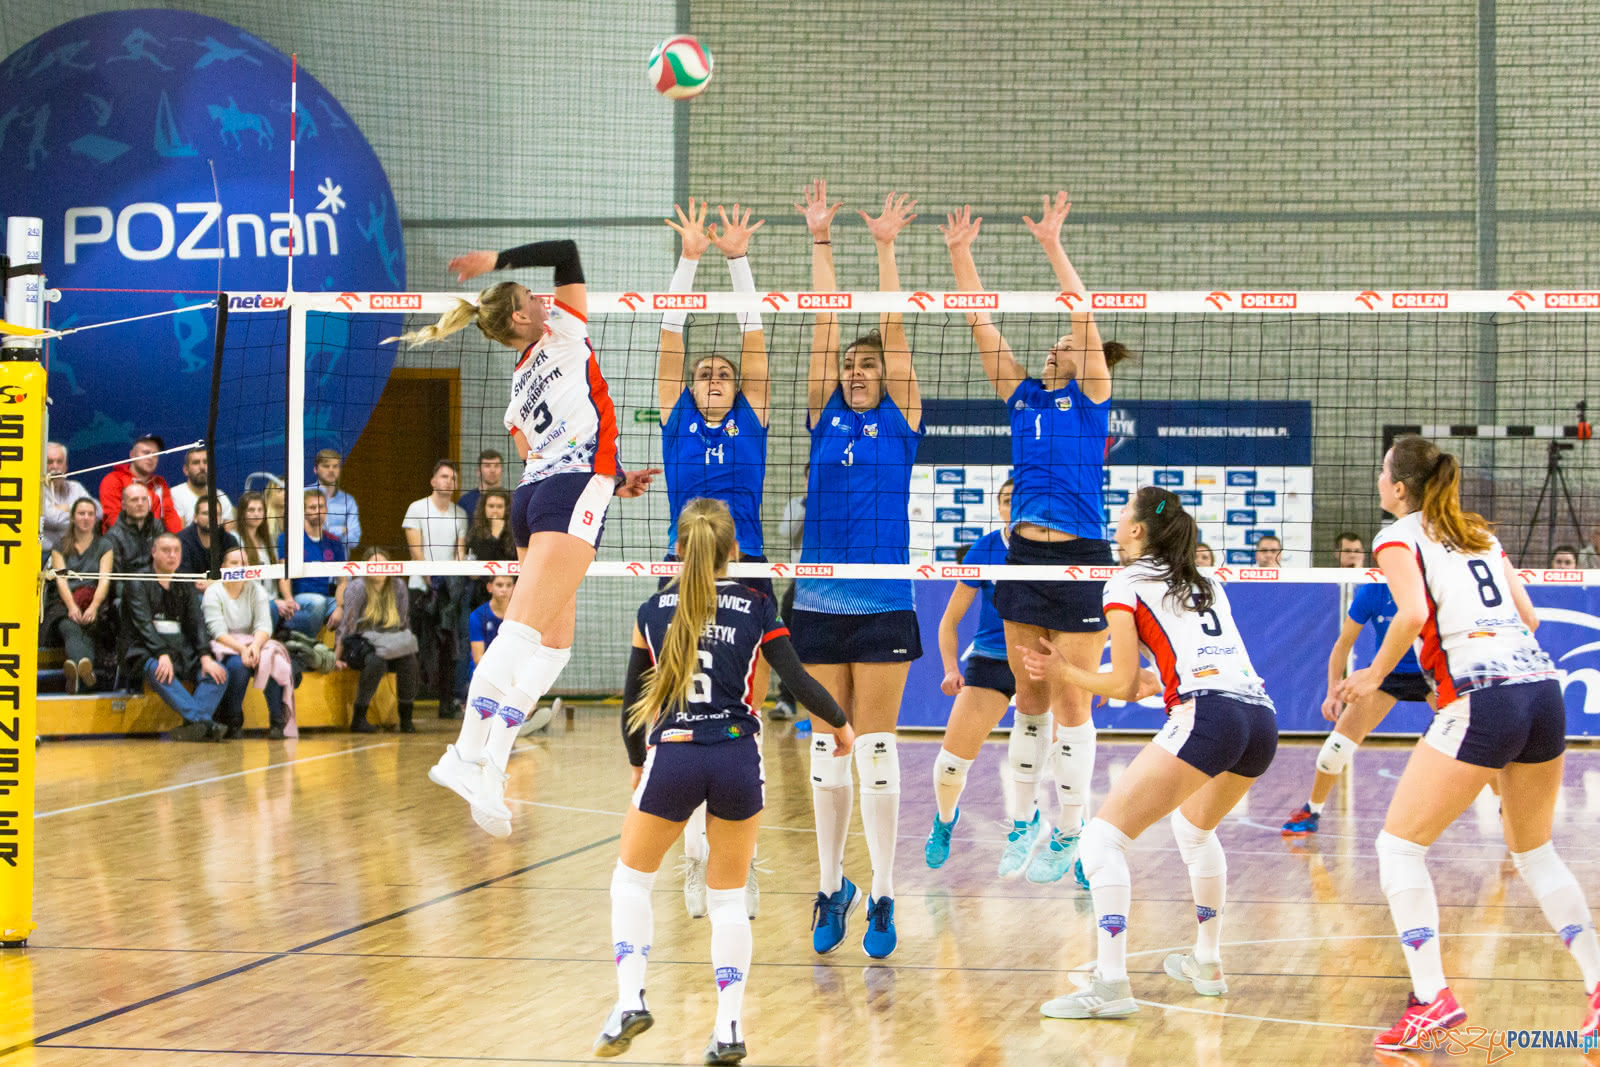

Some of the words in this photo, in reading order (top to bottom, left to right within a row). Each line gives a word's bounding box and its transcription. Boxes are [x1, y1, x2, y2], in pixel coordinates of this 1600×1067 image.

[228, 294, 286, 309] netex
[370, 295, 421, 308] ORLEN
[654, 295, 706, 308] ORLEN
[798, 294, 851, 308] ORLEN
[945, 294, 998, 307] ORLEN
[1092, 294, 1146, 308] ORLEN
[1242, 294, 1295, 308] ORLEN
[1393, 294, 1447, 308] ORLEN
[1545, 294, 1599, 307] ORLEN
[532, 400, 553, 434] 3
[1035, 413, 1042, 440] 1
[705, 443, 724, 464] 14
[223, 569, 262, 580] netex
[367, 563, 403, 573] ORLEN
[796, 566, 833, 576] ORLEN
[942, 567, 980, 577] ORLEN
[1240, 569, 1278, 580] ORLEN
[1467, 559, 1503, 608] 8
[1544, 571, 1583, 582] ORLEN
[1191, 592, 1223, 637] 5
[685, 650, 713, 704] 6
